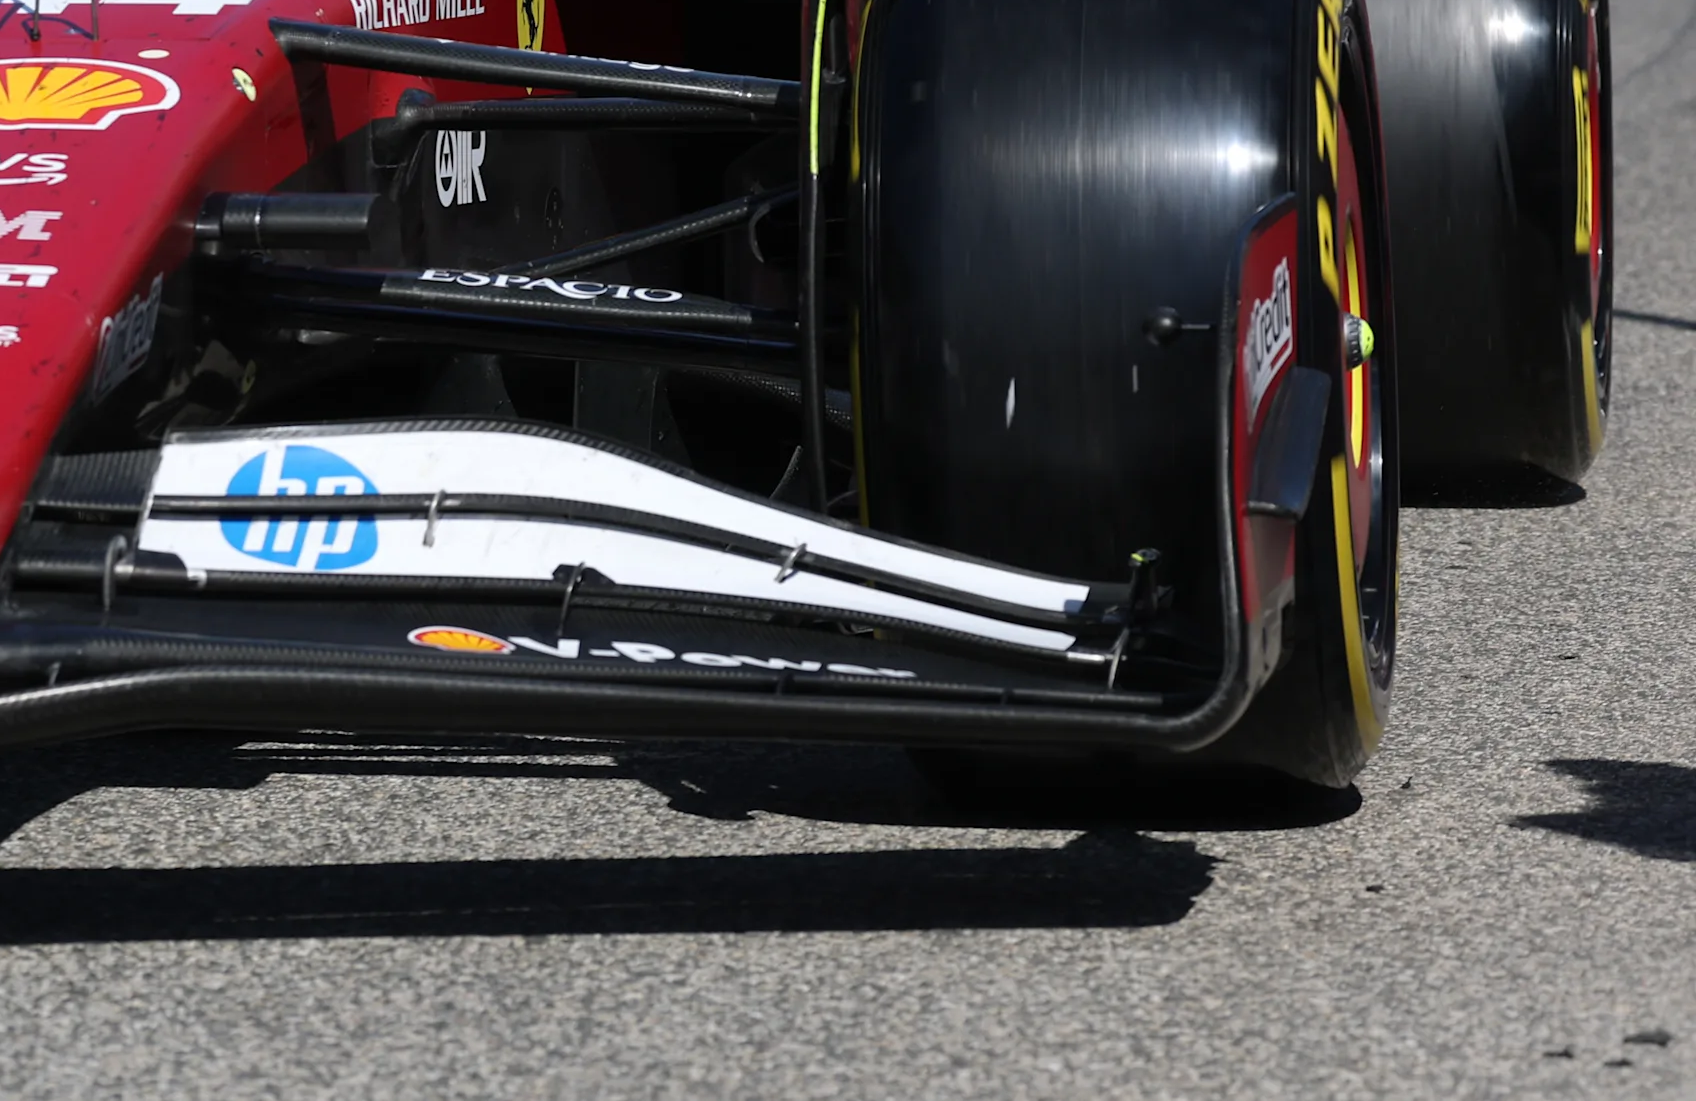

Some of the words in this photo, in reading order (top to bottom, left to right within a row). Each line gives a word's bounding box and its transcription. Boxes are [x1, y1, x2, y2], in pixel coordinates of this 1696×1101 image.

[418, 268, 684, 303] ESPACIO
[242, 446, 366, 571] hp
[507, 635, 917, 679] V-Power
